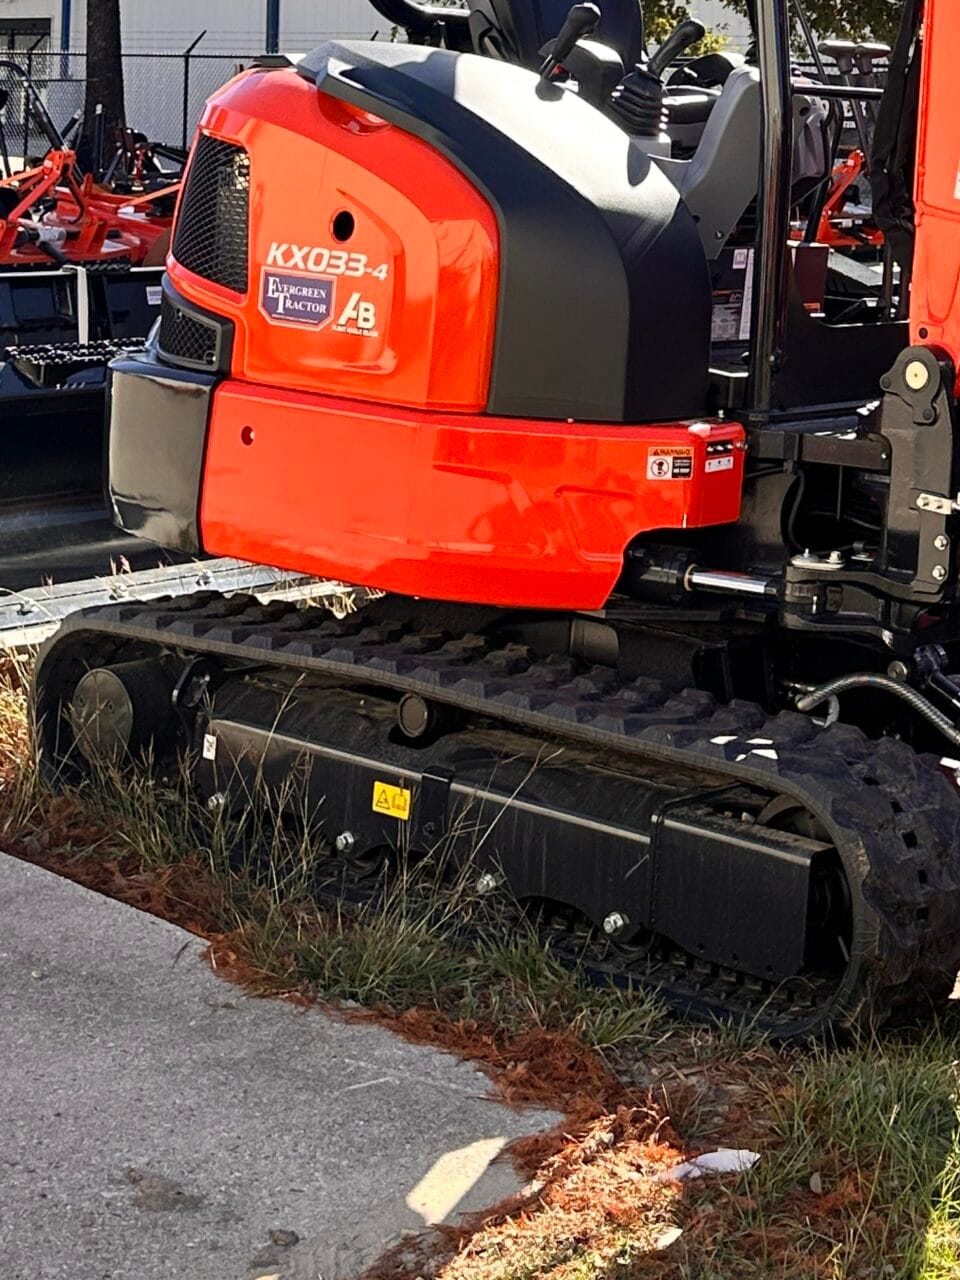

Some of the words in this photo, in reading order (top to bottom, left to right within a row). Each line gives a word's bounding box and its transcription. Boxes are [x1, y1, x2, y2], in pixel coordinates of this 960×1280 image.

[266, 241, 389, 281] KX033-4
[267, 276, 327, 299] EVERGREEN
[275, 291, 327, 314] TRACTOR
